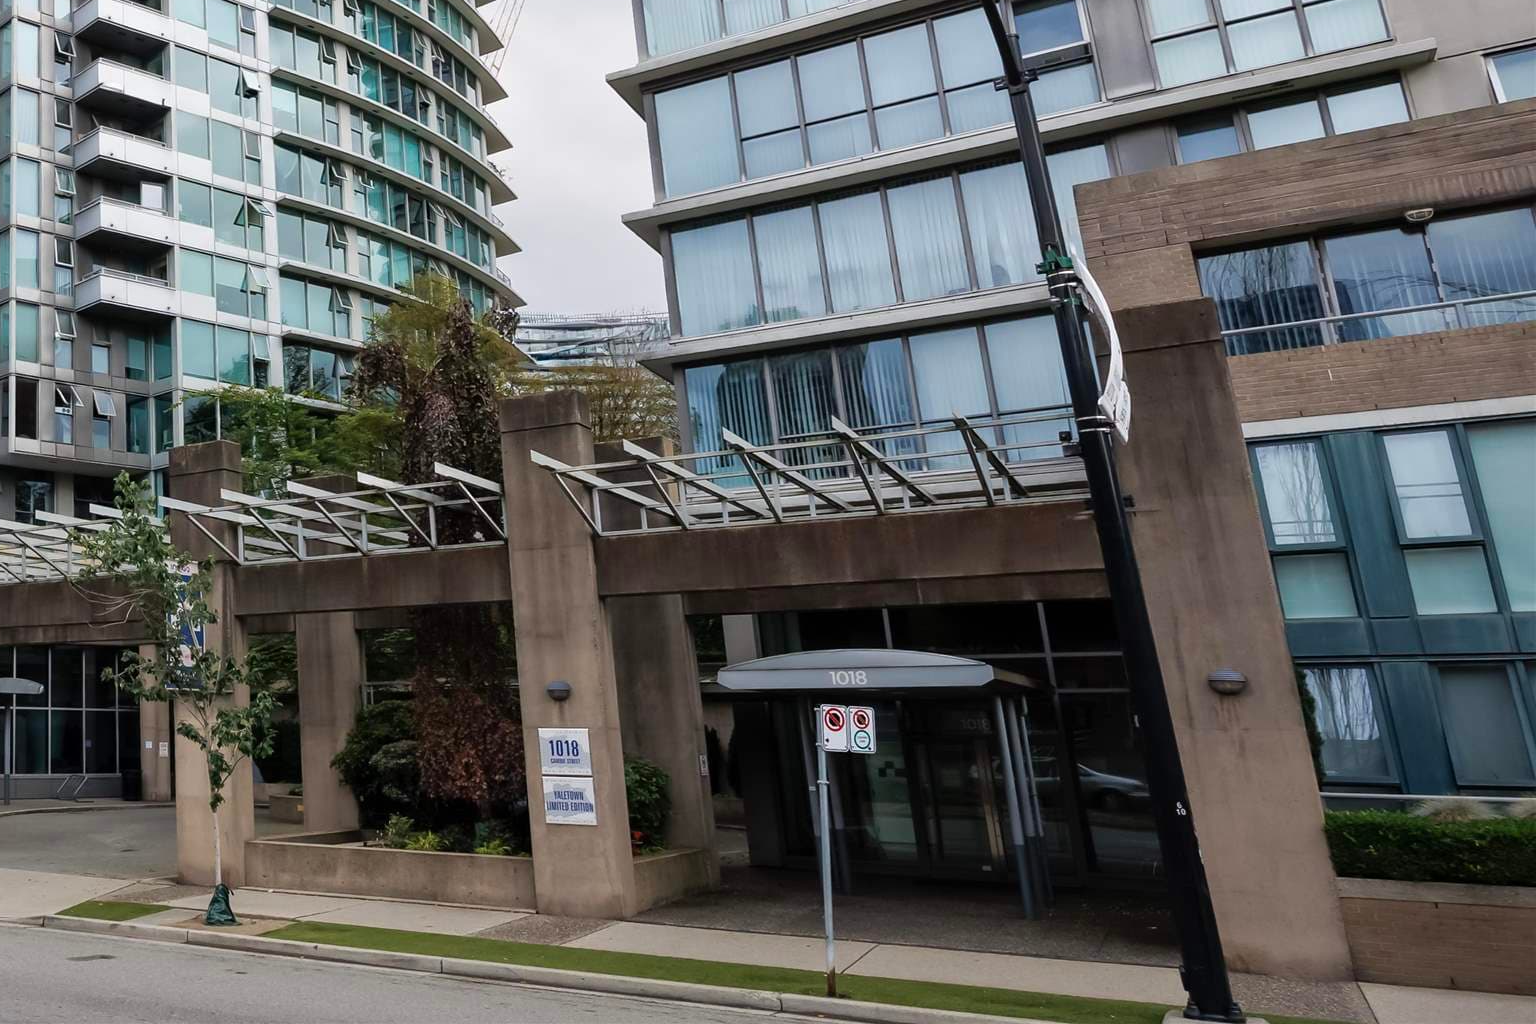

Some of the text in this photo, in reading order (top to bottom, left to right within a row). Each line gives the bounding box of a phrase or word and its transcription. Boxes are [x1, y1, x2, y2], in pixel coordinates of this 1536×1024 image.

[829, 670, 868, 685] 1018
[548, 739, 580, 757] 1018
[553, 790, 584, 801] YALETOWN
[546, 800, 594, 813] LIMITED EDITION
